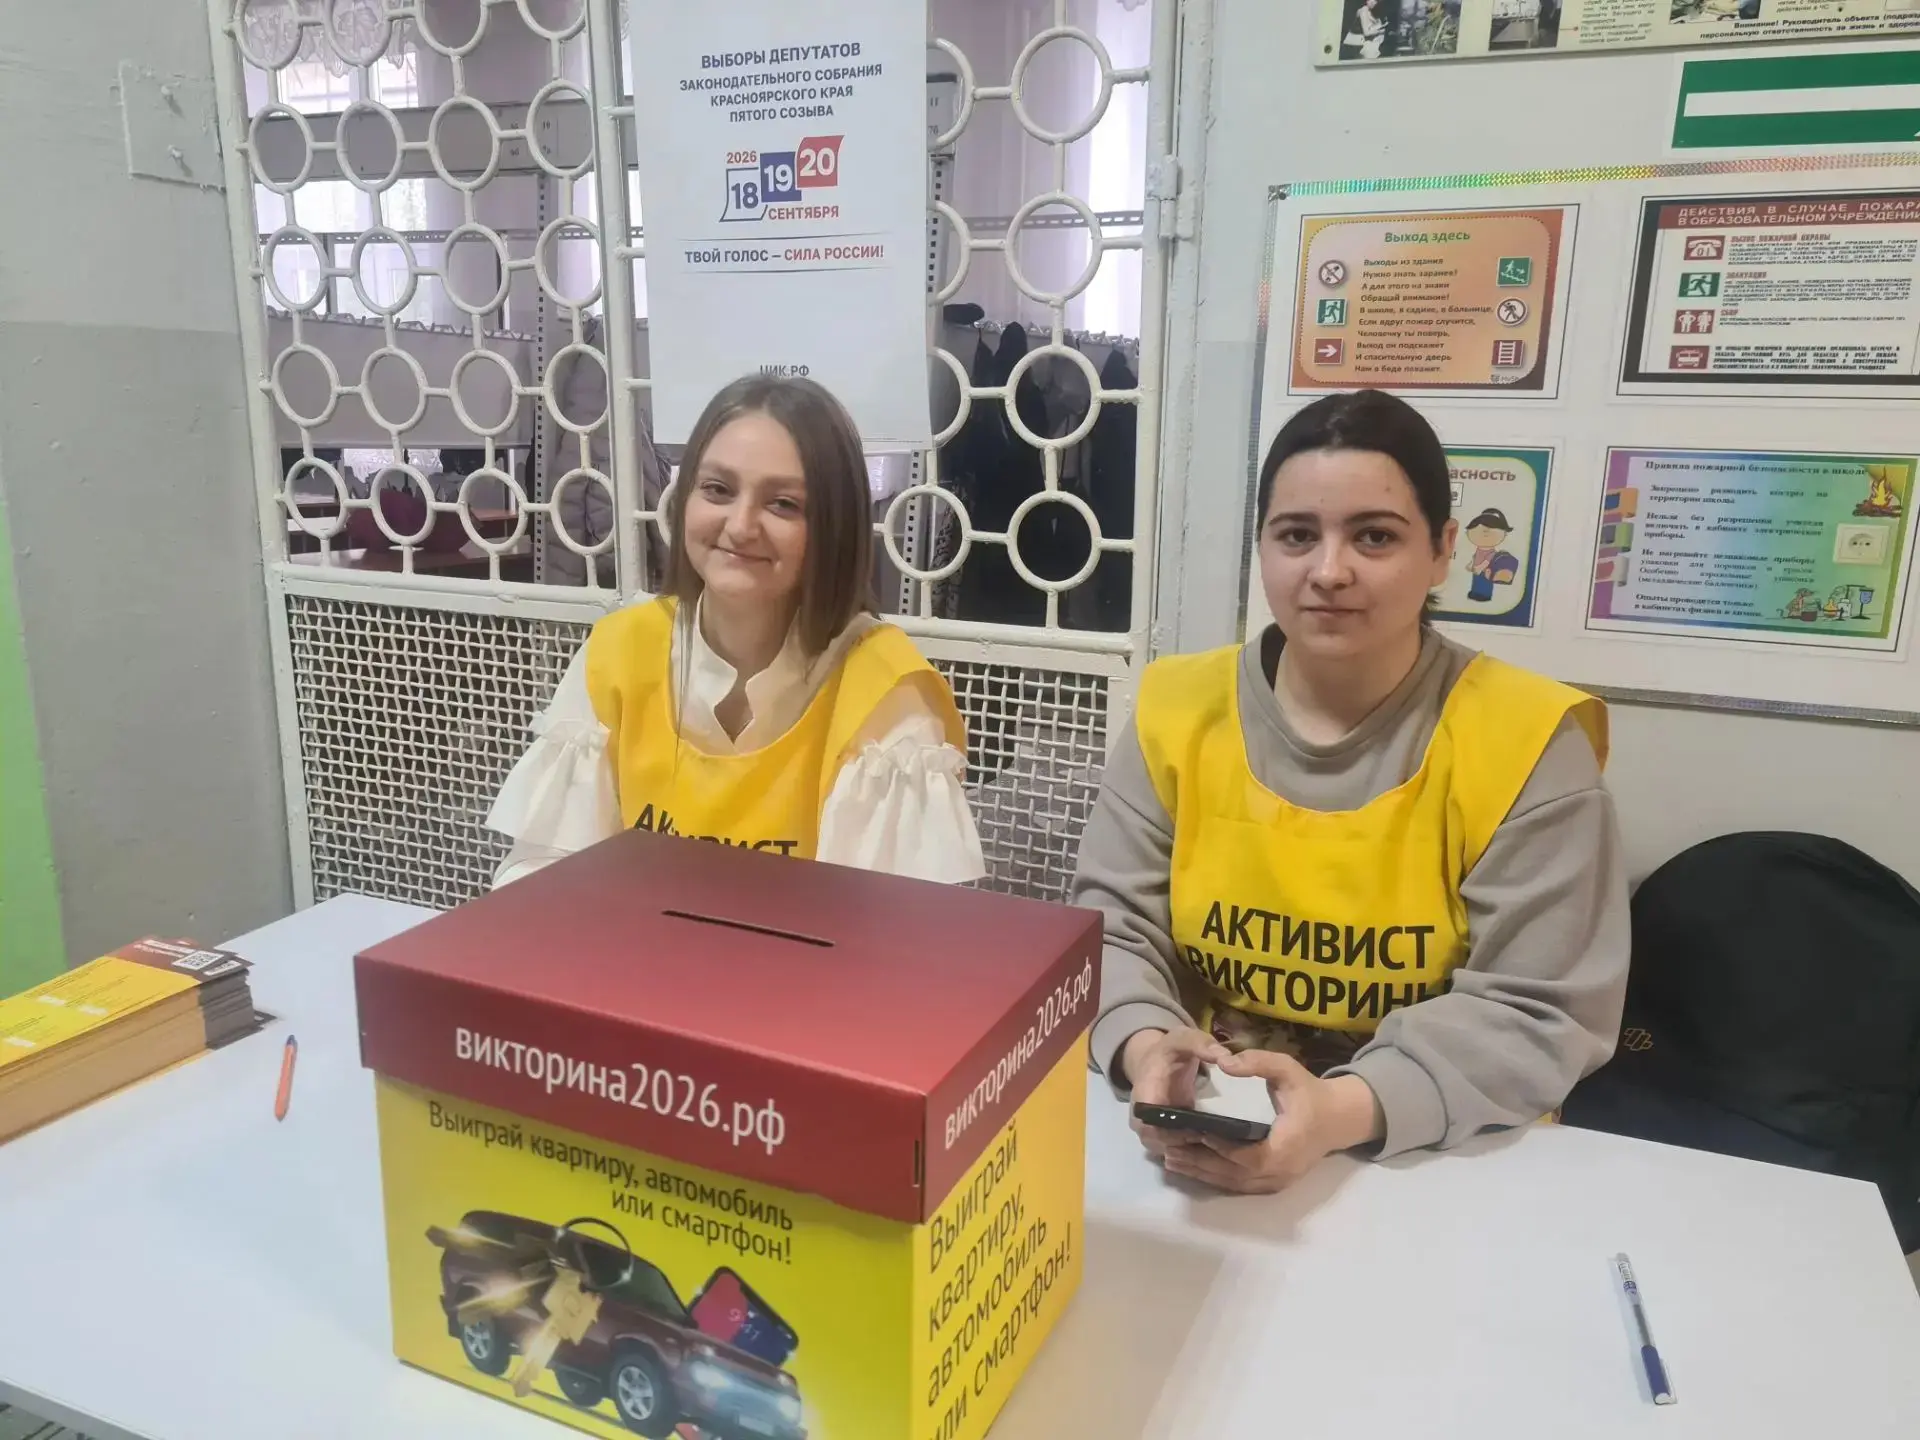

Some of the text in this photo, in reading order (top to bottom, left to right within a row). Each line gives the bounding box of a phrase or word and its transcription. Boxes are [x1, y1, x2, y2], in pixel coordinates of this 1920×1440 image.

[1734, 20, 1778, 28] Внимание!
[1782, 16, 1841, 26] Руководитель
[1844, 14, 1880, 23] объекта
[1700, 30, 1759, 39] персональную
[1762, 27, 1832, 36] ответственность
[701, 42, 861, 69] ВЫБОРЫ ДЕПУТАТОВ
[680, 64, 882, 91] ЗАКОНОДАТЕЛЬНОГО СОБРАНИЯ
[710, 85, 853, 107] КРАСНОЯРСКОГО КРАЯ
[730, 104, 834, 122] ПЯТОГО СОЗЫВА
[726, 150, 757, 164] 2026
[799, 147, 836, 177] 20
[764, 164, 793, 192] 19
[731, 182, 759, 210] 18
[768, 206, 839, 220] СЕНТЯБРЯ
[1678, 206, 1756, 218] ДЕЙСТВИЯ
[1768, 206, 1776, 214] В
[1788, 203, 1848, 214] СЛУЧАЕ
[1678, 217, 1687, 226] В
[1690, 214, 1826, 225] ОБРАЗОВАТЕЛЬНОМ
[1384, 230, 1470, 243] Выход здесь
[685, 248, 721, 264] ТВОЙ
[724, 250, 769, 263] ГОЛОС
[784, 248, 820, 262] СИЛА
[824, 245, 884, 260] РОССИИ!
[1697, 248, 1711, 258] 01
[1364, 259, 1398, 267] Выходы
[1412, 258, 1444, 266] здания
[1363, 271, 1391, 280] Нужно
[1360, 294, 1400, 302] Обращай
[1406, 318, 1434, 326] пожар
[1436, 318, 1476, 326] случится,
[1358, 330, 1401, 338] Человечку
[1417, 330, 1450, 338] поверь,
[1364, 354, 1422, 362] спасительную
[1425, 354, 1452, 362] дверь
[1381, 364, 1401, 372] беде
[1646, 461, 1690, 470] Правила
[1692, 464, 1745, 472] пожарной
[1748, 464, 1820, 473] безопасности
[1450, 468, 1516, 482] асность
[1650, 485, 1700, 493] Запрещено
[1650, 495, 1700, 504] территории
[1646, 512, 1678, 520] Нельзя
[1690, 514, 1704, 522] без
[1642, 548, 1654, 556] Не
[1640, 567, 1679, 575] Особенно
[1636, 594, 1668, 602] Опыты
[1642, 604, 1686, 612] кабинетах
[1200, 900, 1435, 970] АКТИВИСТ
[945, 956, 1092, 1151] викторина2026.рф
[455, 1027, 786, 1155] викторина2026.рф
[429, 1101, 793, 1231] Выиграй квартиру, автомобиль
[930, 1117, 1018, 1274] Выиграй
[612, 1189, 792, 1265] или смартфон!
[929, 1183, 1025, 1342] квартиру,
[928, 1216, 1047, 1408] автомобиль
[974, 1221, 1072, 1397] смартфон!
